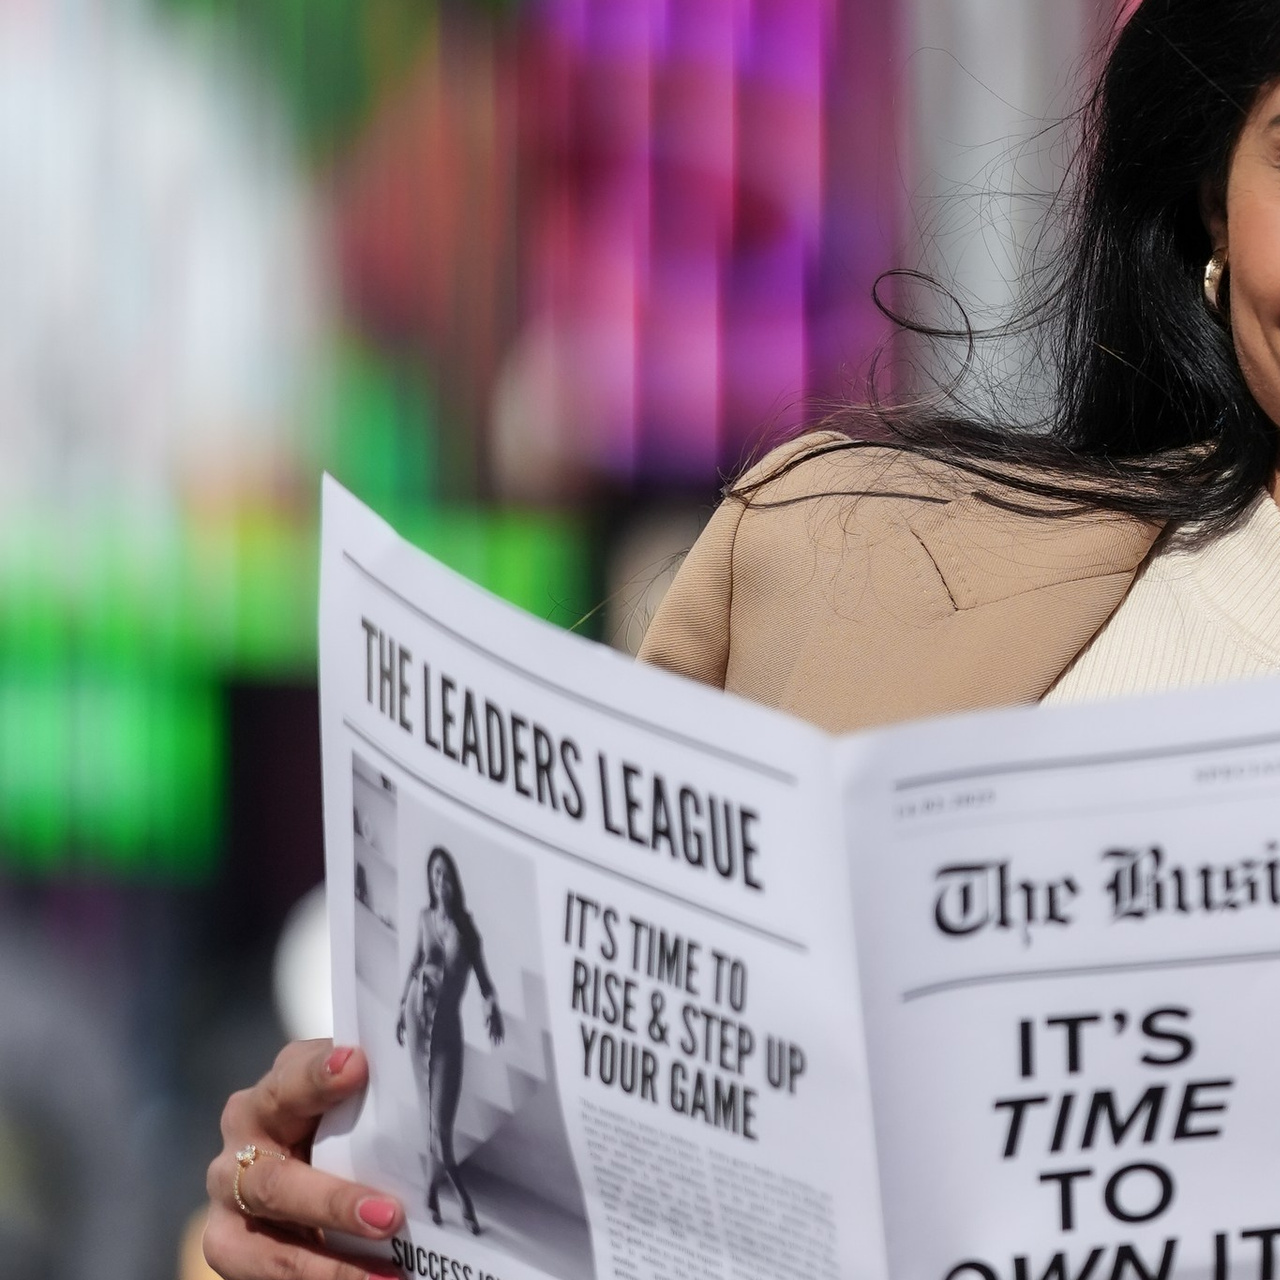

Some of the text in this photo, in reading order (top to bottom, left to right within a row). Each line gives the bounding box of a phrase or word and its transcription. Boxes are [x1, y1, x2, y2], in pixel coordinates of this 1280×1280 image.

[361, 615, 764, 891] THE LEADERS LEAGUE
[564, 889, 749, 1014] IT'S TIME TO
[934, 856, 1078, 948] The
[571, 957, 808, 1093] RISE & STEP UP
[1019, 1005, 1195, 1078] IT'S
[580, 1022, 760, 1141] YOUR GAME
[994, 1078, 1234, 1159] TIME
[1039, 1162, 1176, 1231] TO
